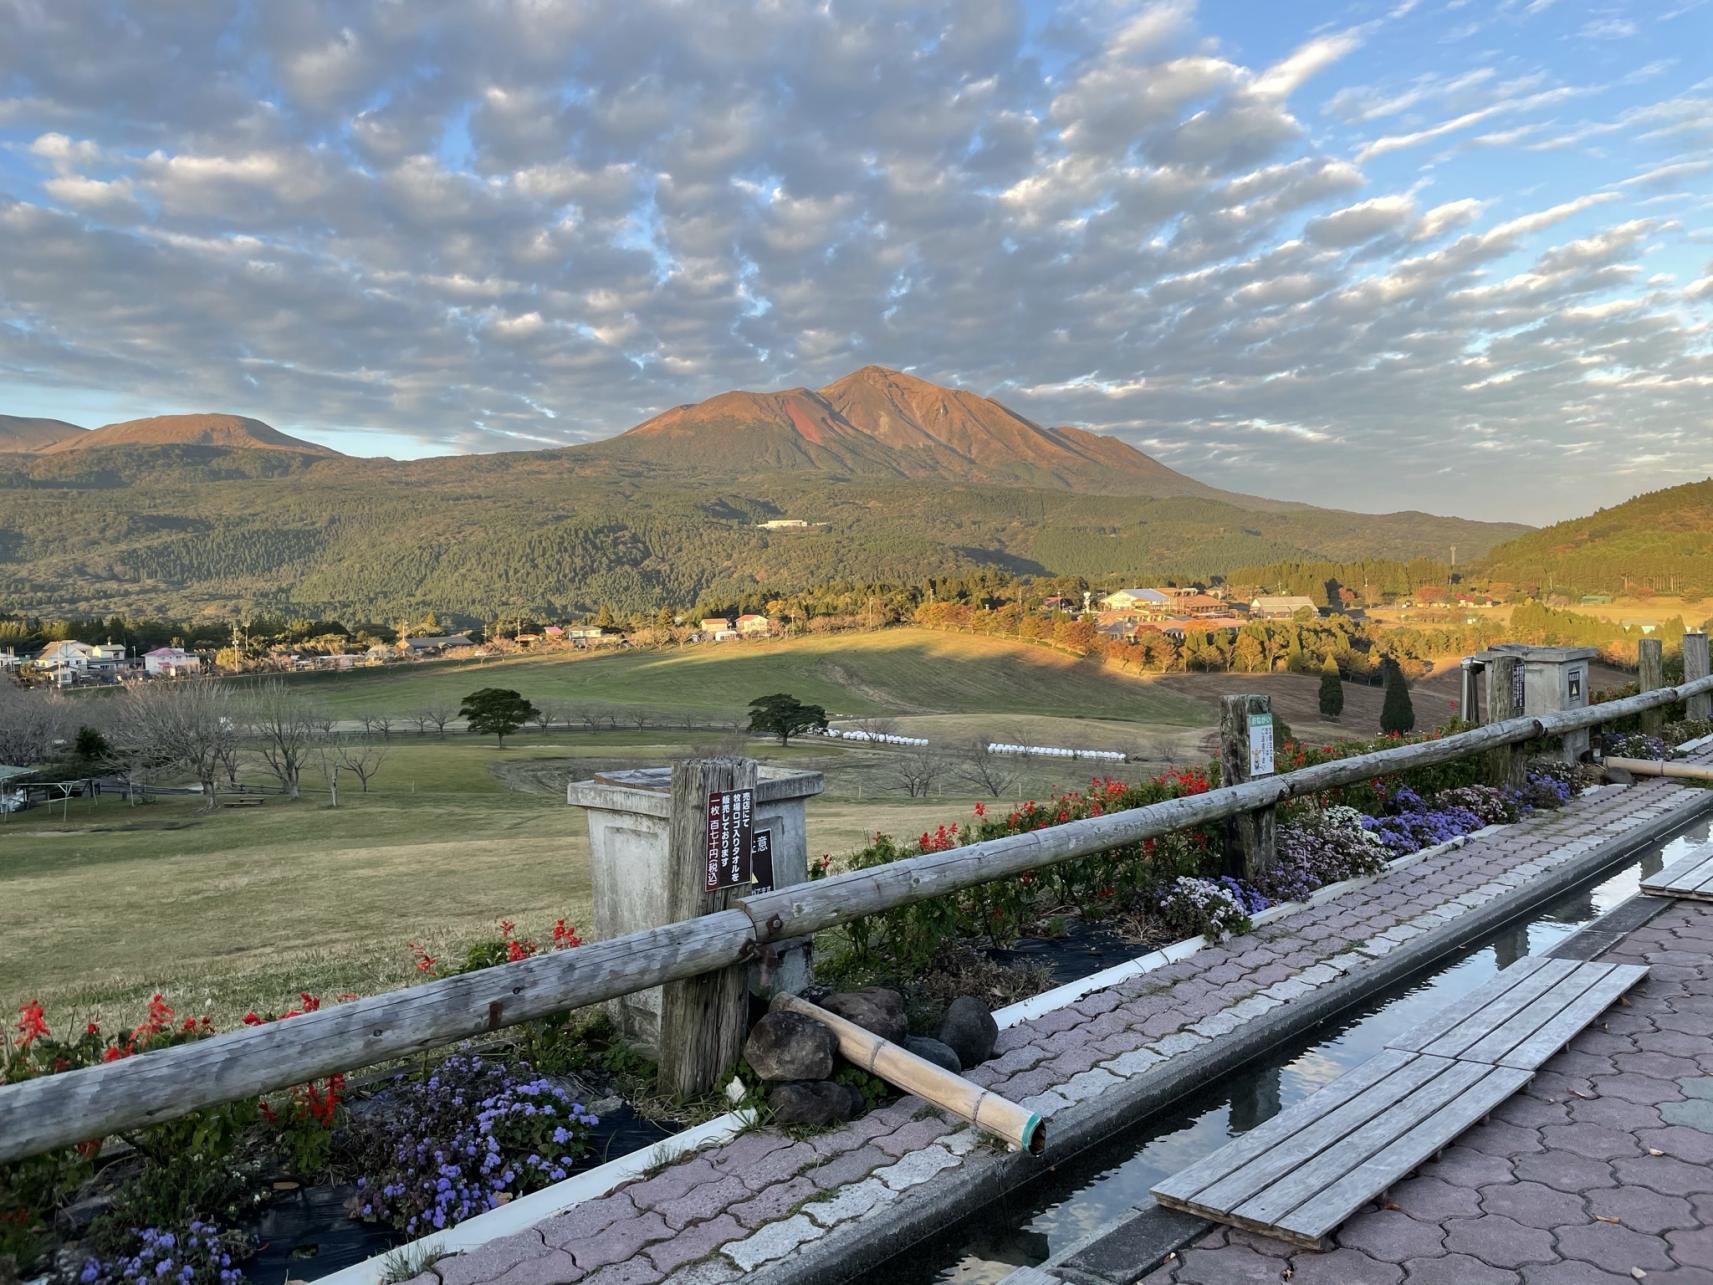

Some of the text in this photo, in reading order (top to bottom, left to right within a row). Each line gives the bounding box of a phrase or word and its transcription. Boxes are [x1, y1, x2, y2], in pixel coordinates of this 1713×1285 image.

[721, 795, 730, 867] 販売しております
[732, 793, 741, 882] 牧場ロゴ入りタオルを
[742, 792, 750, 827] 売店にて
